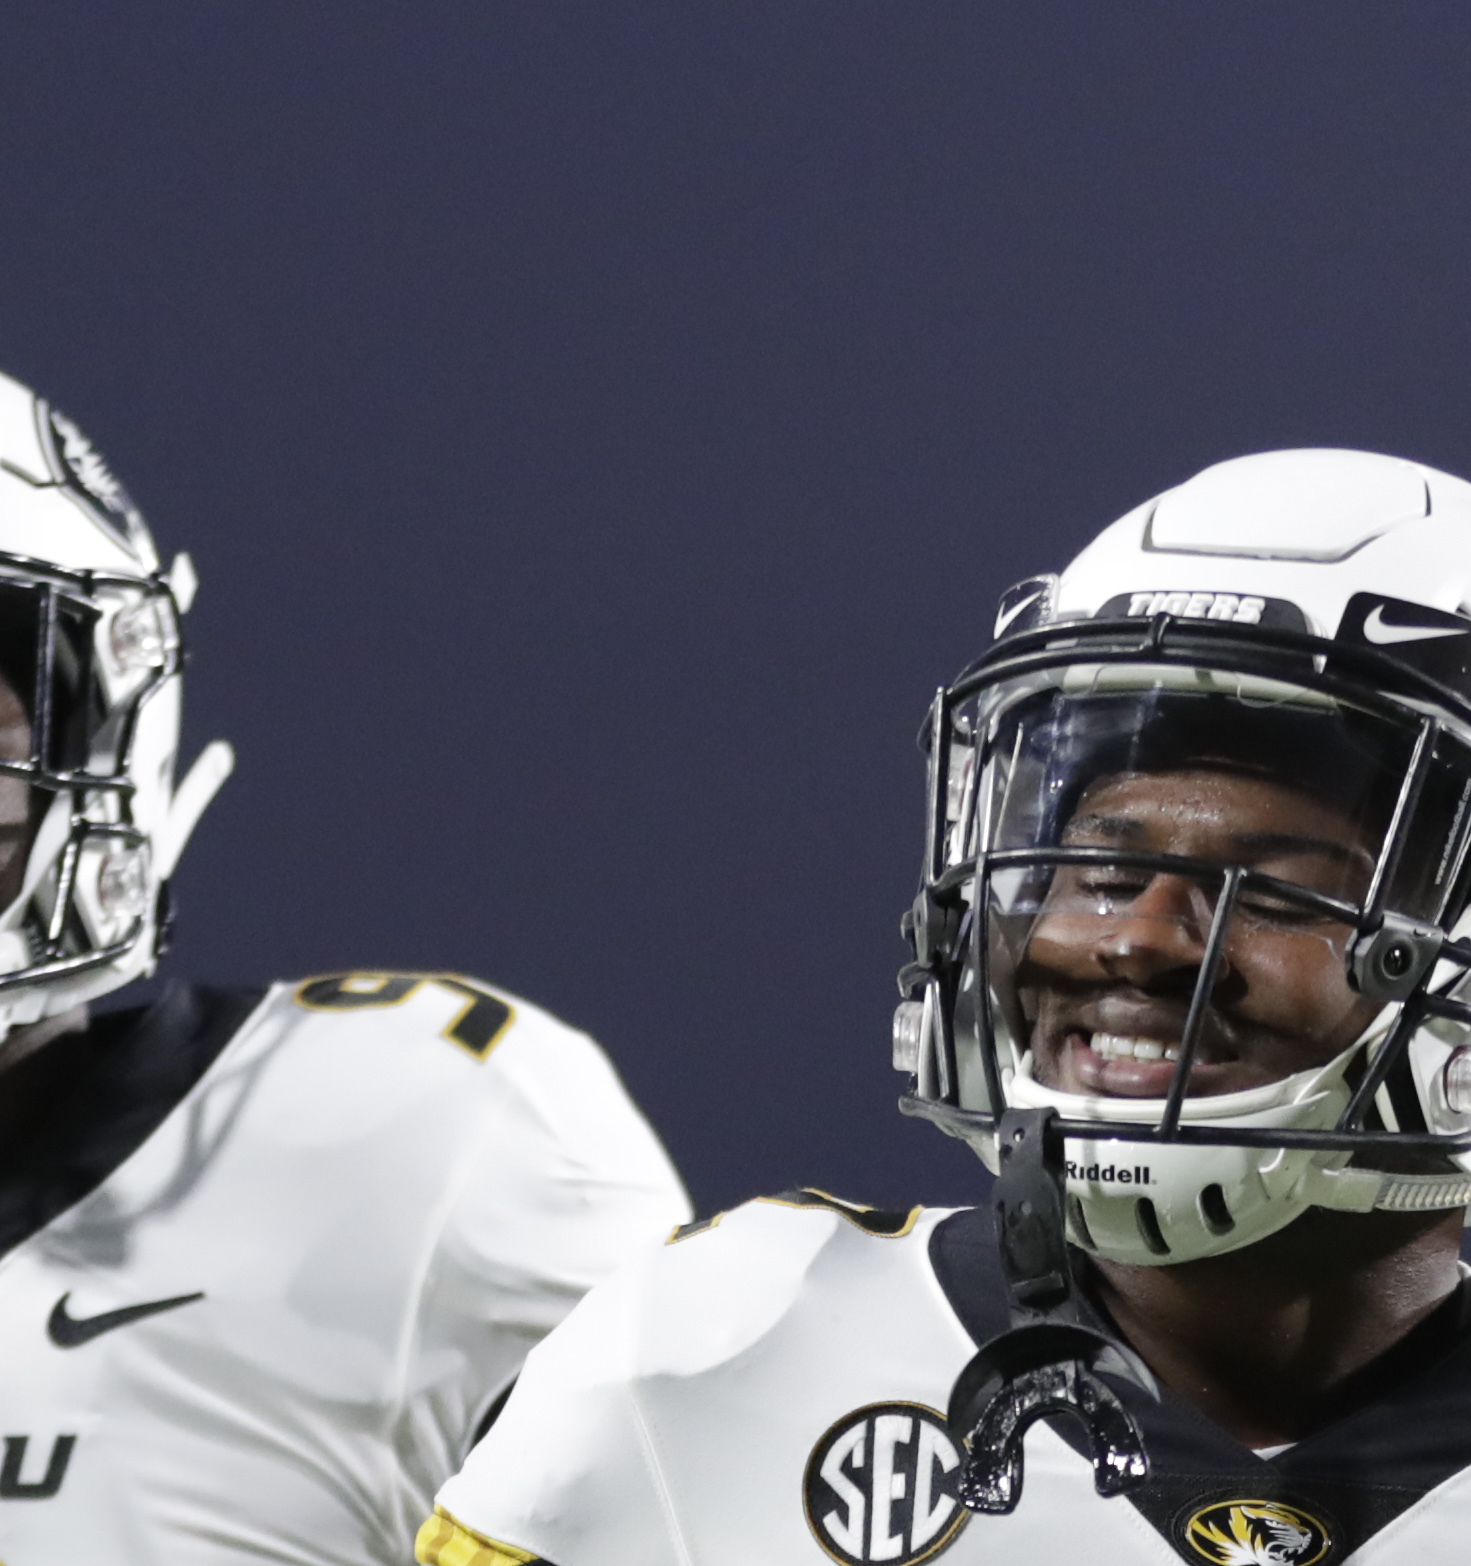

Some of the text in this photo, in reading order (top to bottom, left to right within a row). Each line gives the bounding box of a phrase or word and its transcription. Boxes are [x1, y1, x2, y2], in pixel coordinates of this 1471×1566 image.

[1128, 592, 1266, 625] TIGERS
[1065, 1161, 1150, 1184] Riddell
[820, 1414, 960, 1561] SEC
